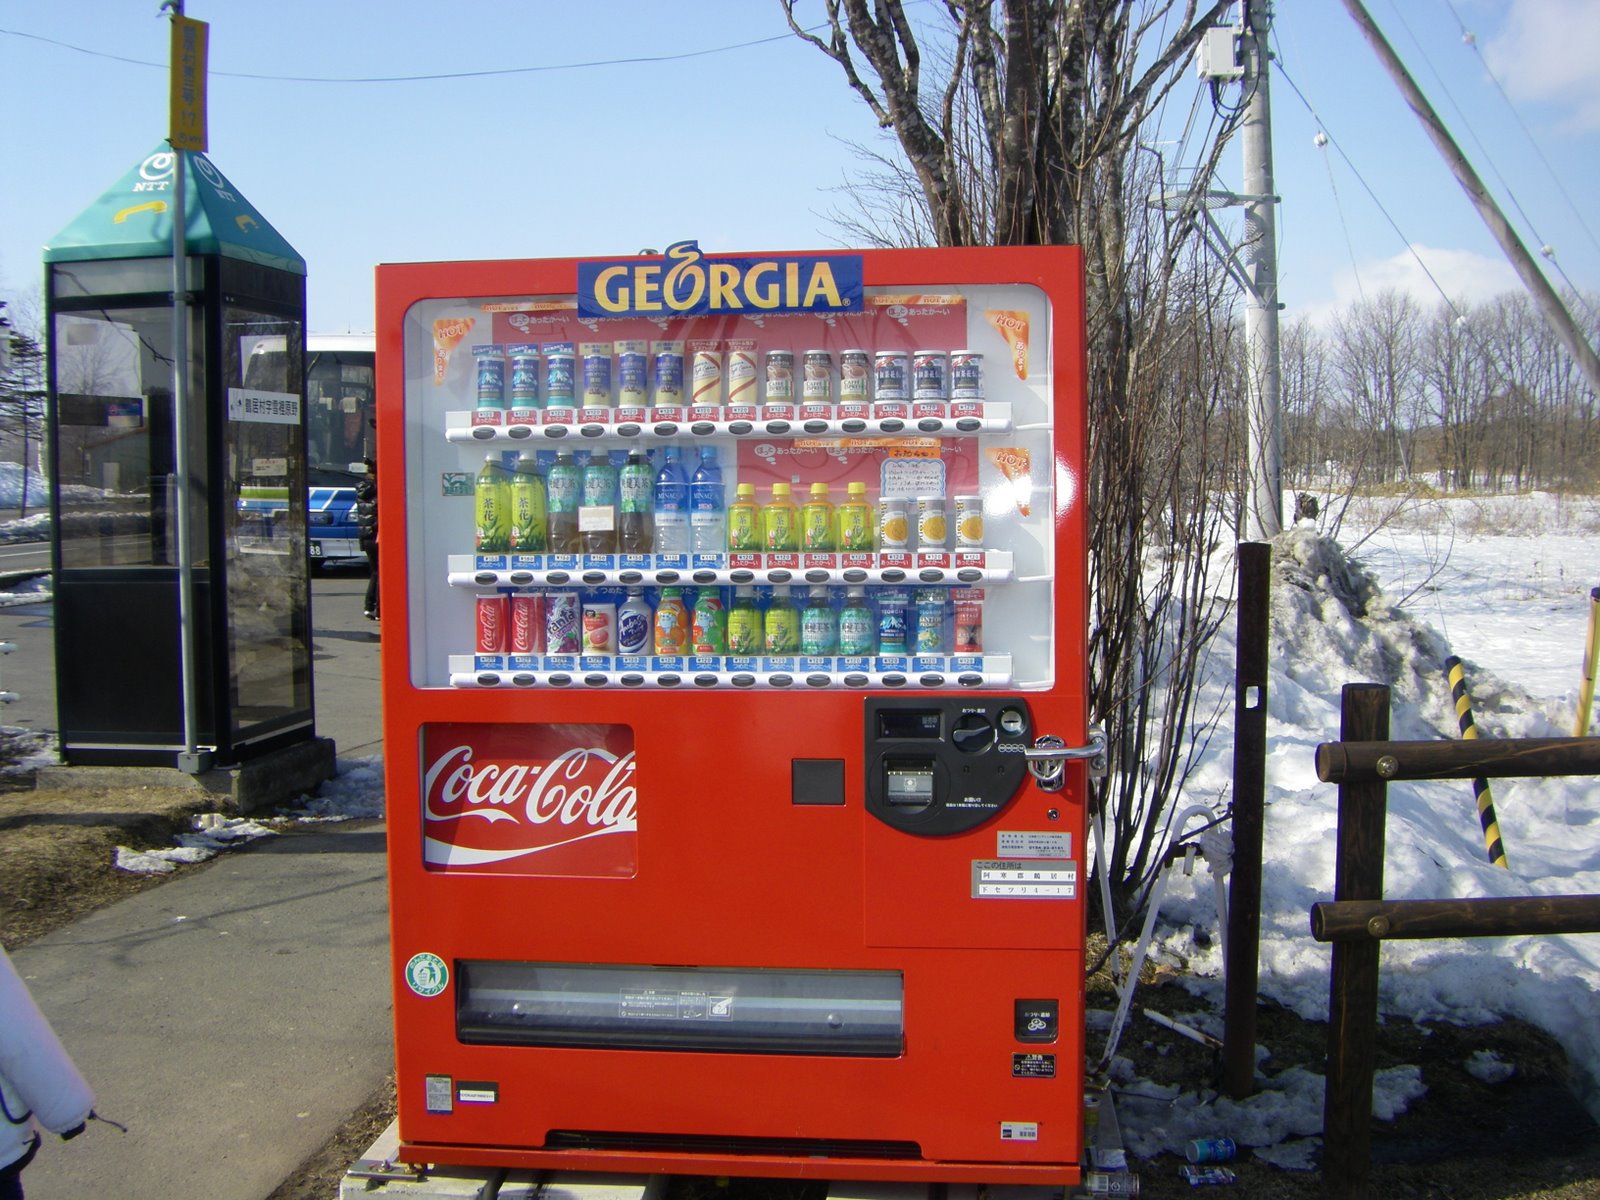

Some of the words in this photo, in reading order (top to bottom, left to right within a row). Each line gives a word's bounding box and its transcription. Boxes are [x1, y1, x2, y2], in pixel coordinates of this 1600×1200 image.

[132, 181, 169, 192] NTT
[594, 243, 843, 312] GEORGIA
[438, 322, 464, 340] HOT
[996, 314, 1025, 330] HOT
[483, 498, 494, 522] 茶花
[519, 497, 529, 521] 茶花
[425, 745, 637, 826] Coca-Cola
[976, 861, 1022, 870] ここの住所は
